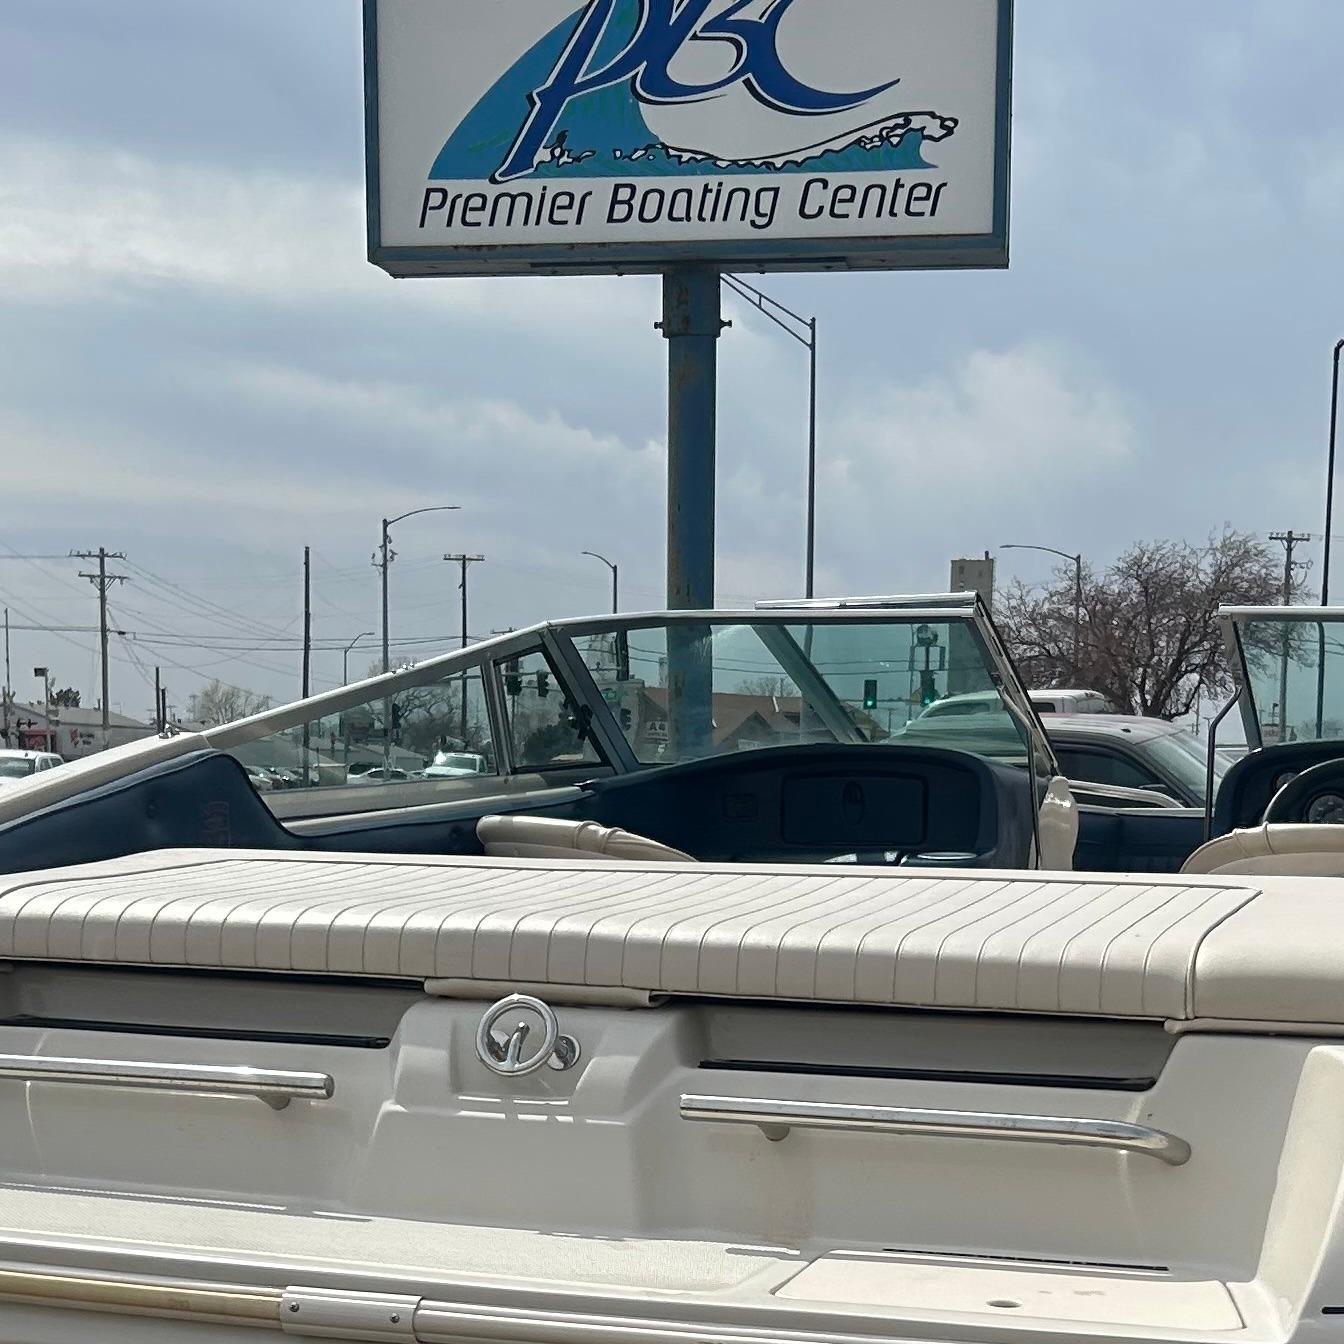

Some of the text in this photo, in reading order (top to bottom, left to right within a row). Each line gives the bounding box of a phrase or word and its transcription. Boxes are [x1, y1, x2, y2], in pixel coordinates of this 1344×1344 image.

[419, 177, 948, 229] Premier Boating Center
